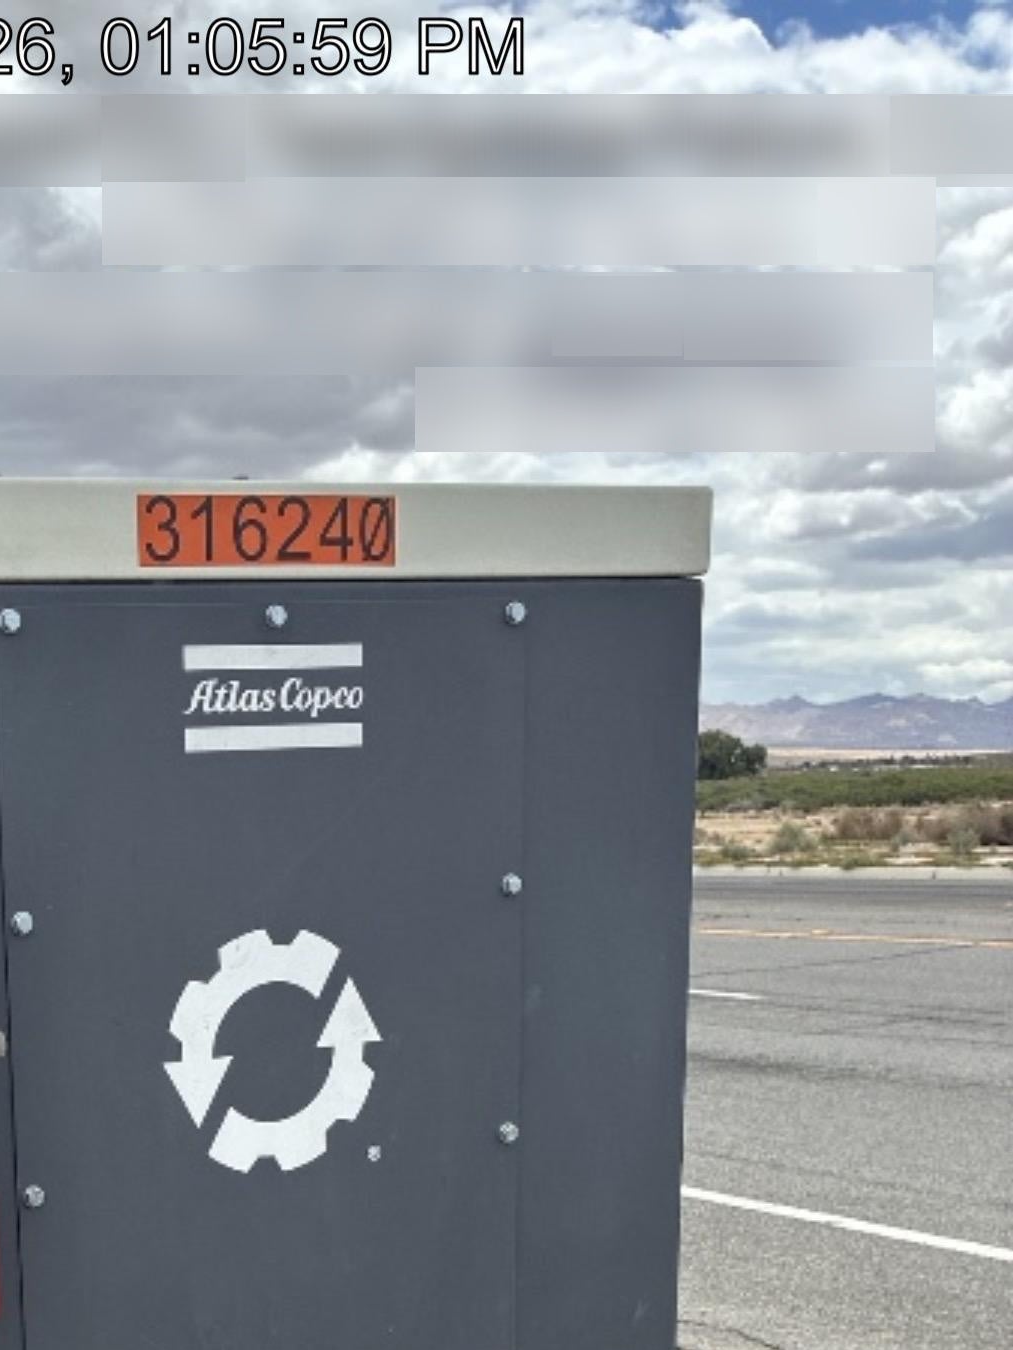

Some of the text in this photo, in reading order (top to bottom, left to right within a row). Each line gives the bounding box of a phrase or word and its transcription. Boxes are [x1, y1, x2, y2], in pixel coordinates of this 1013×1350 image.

[144, 495, 392, 562] 316240
[183, 677, 363, 718] Atlas Copco
